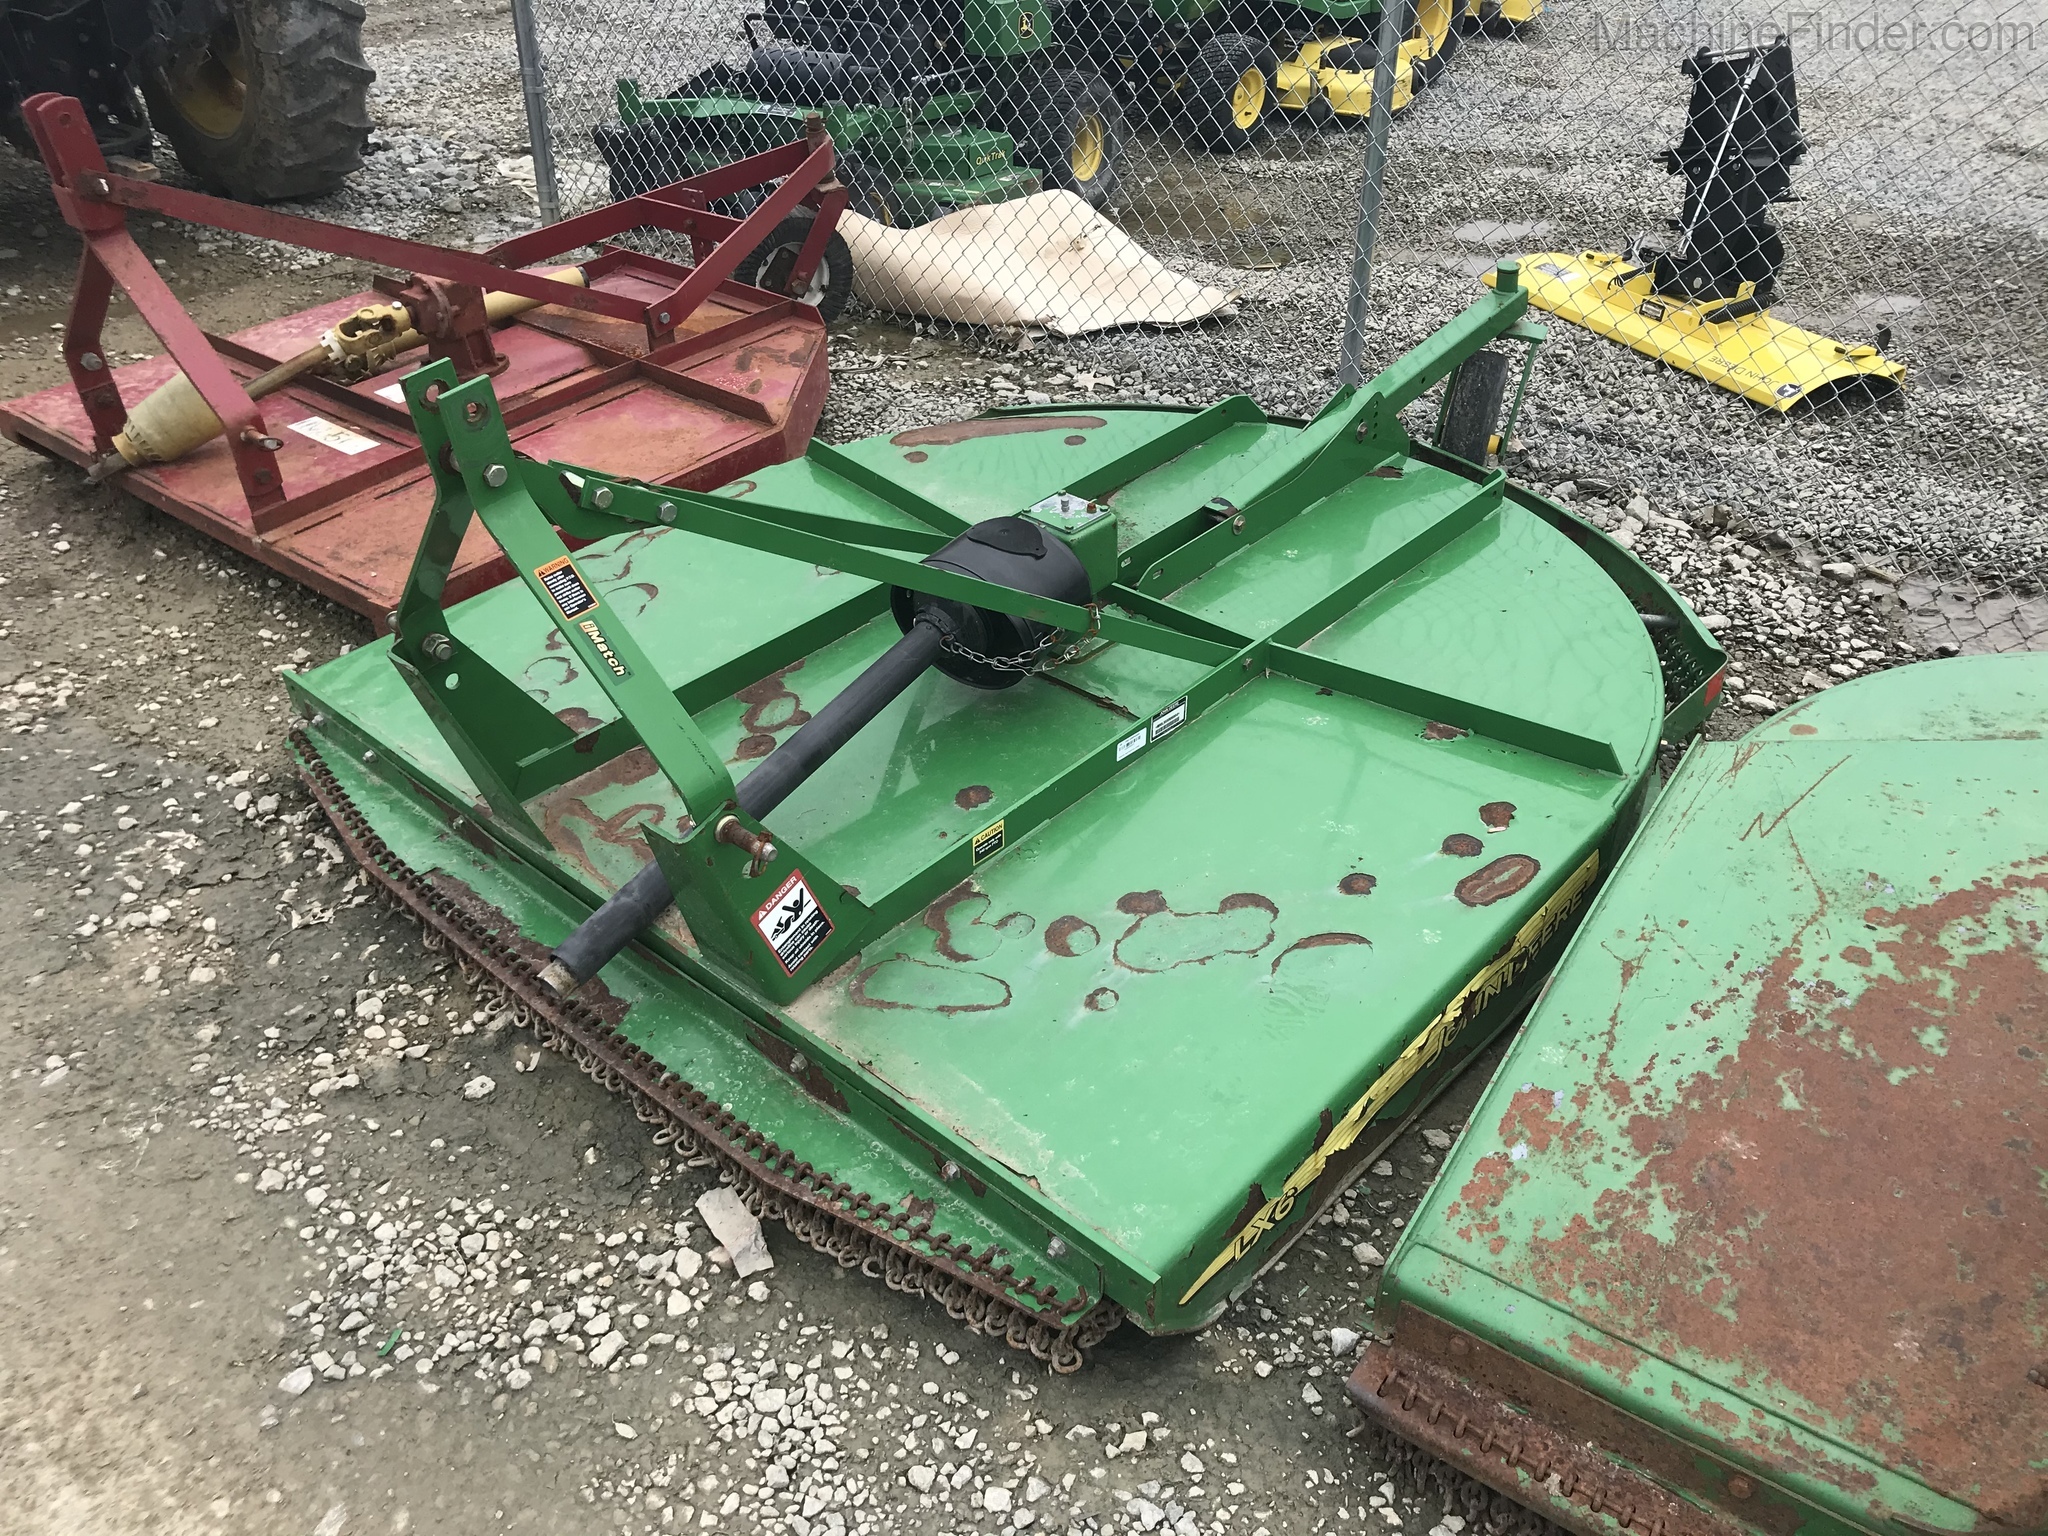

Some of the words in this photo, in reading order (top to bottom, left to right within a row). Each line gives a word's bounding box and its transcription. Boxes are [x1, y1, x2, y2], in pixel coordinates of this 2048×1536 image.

[976, 150, 1006, 166] QukTrak
[544, 558, 569, 573] WARNING
[980, 824, 1003, 840] CAUTION
[765, 876, 797, 910] DANGER
[1234, 1187, 1296, 1261] LX6
